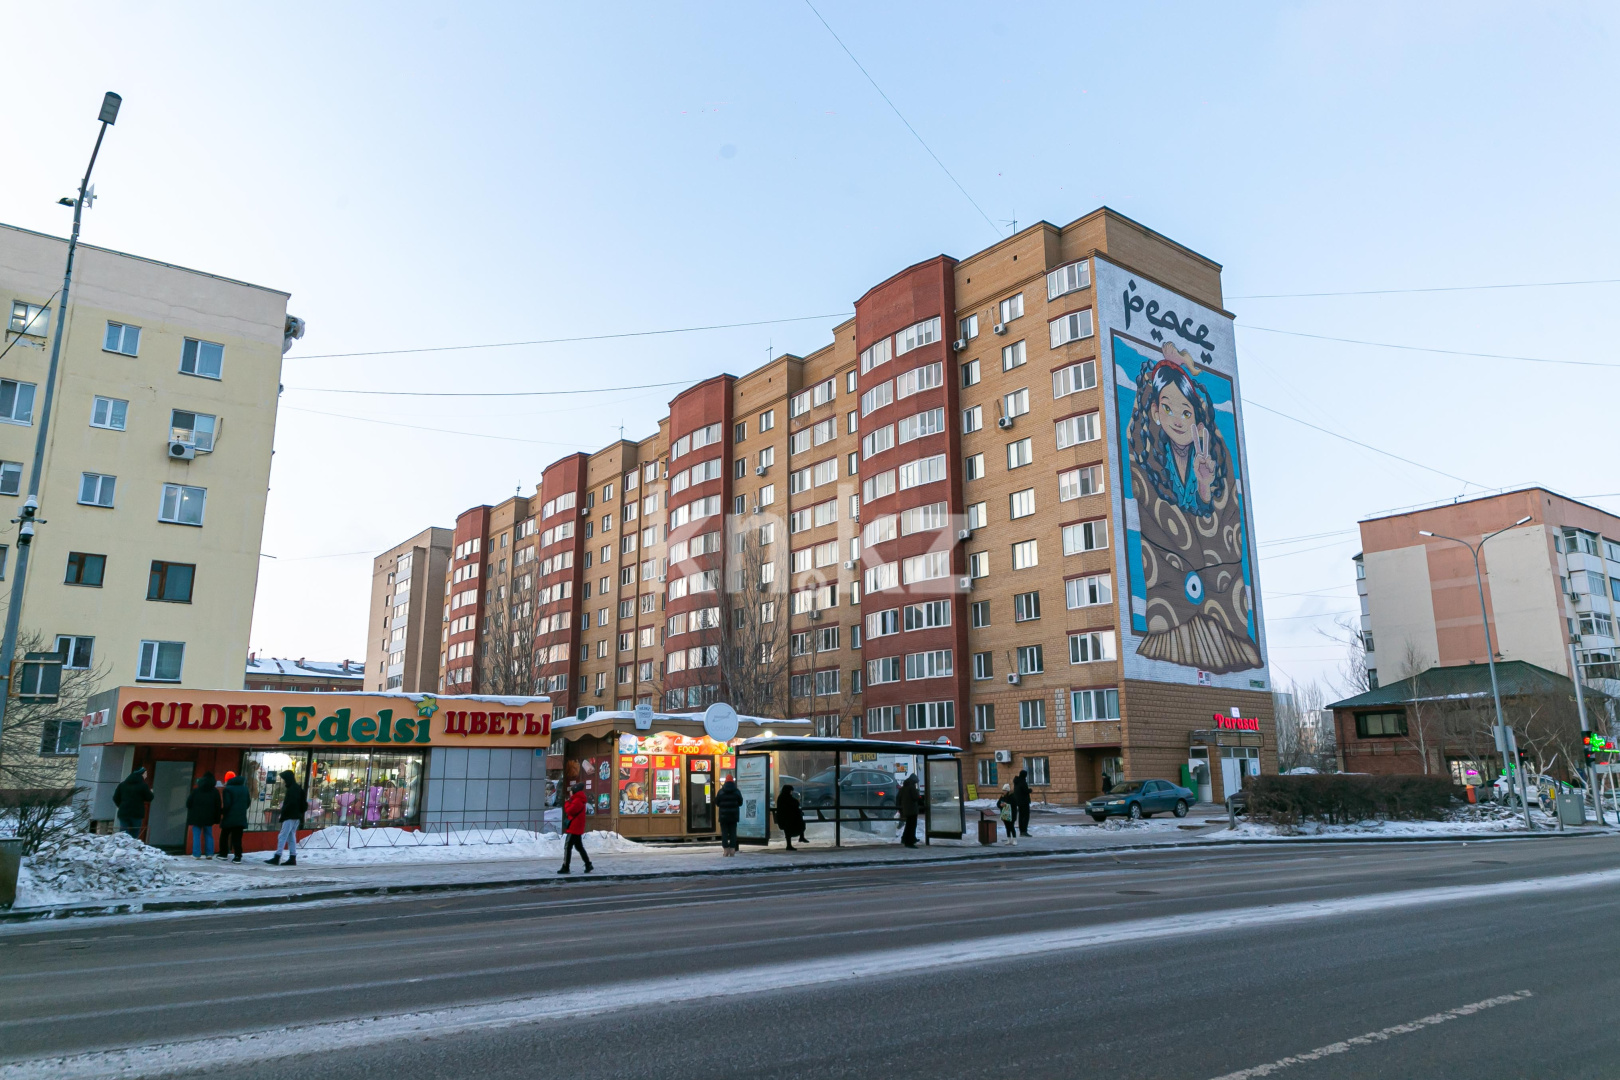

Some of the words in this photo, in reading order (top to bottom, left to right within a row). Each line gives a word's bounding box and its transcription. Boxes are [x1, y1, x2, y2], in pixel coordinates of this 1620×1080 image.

[121, 700, 273, 731] GULDER
[279, 699, 432, 744] Edelsi
[444, 711, 551, 738] ЦВЕТЫ
[1214, 714, 1260, 730] Parasat
[677, 745, 700, 754] FOOD
[852, 752, 876, 761] METRO
